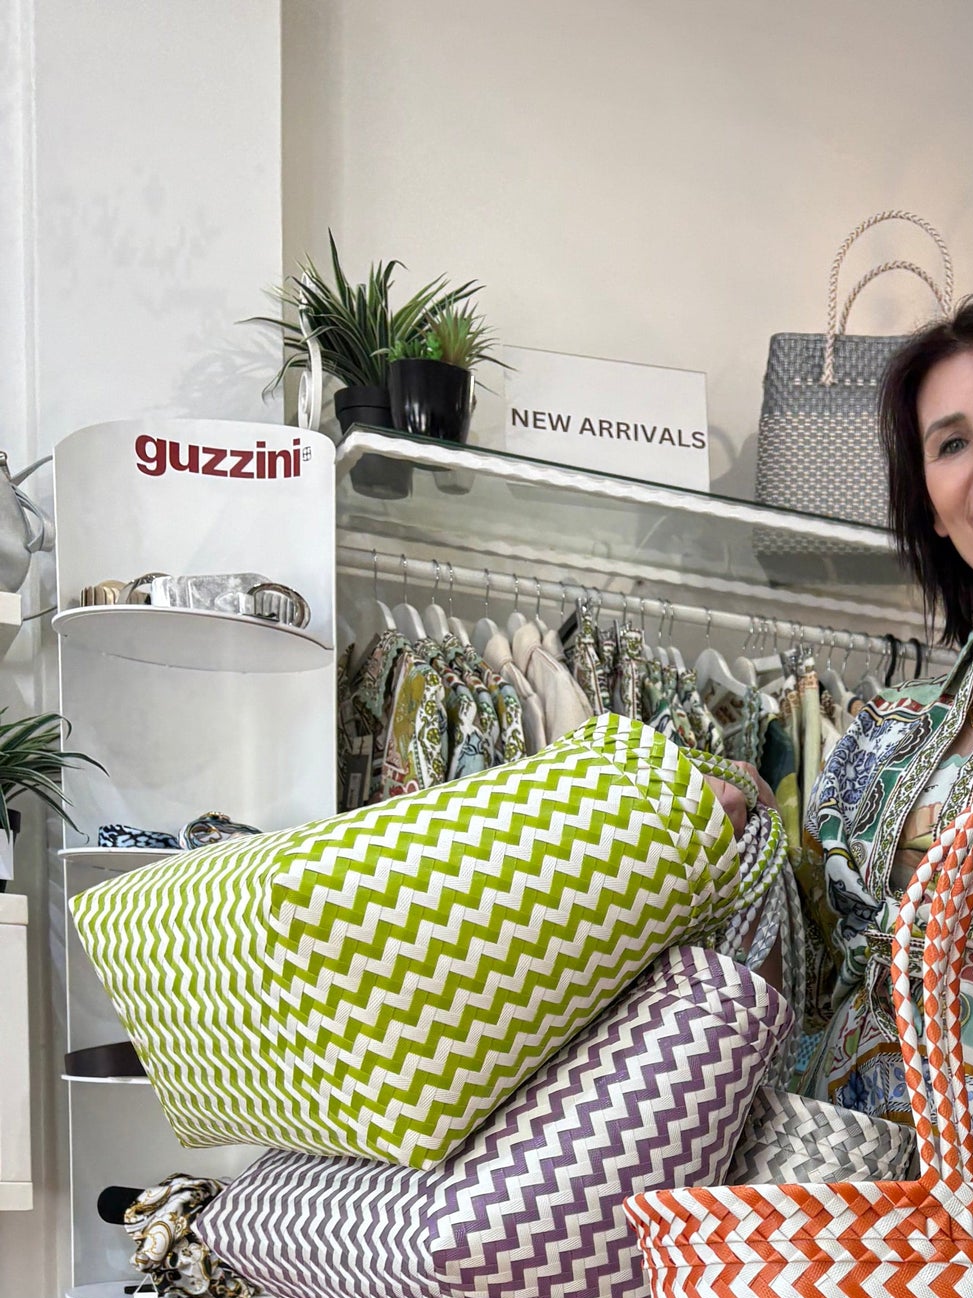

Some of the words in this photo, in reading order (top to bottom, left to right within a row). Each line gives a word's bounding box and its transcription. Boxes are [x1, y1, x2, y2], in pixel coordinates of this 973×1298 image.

[511, 407, 572, 433] NEW
[578, 417, 706, 449] ARRIVALS
[134, 434, 301, 479] guzzini
